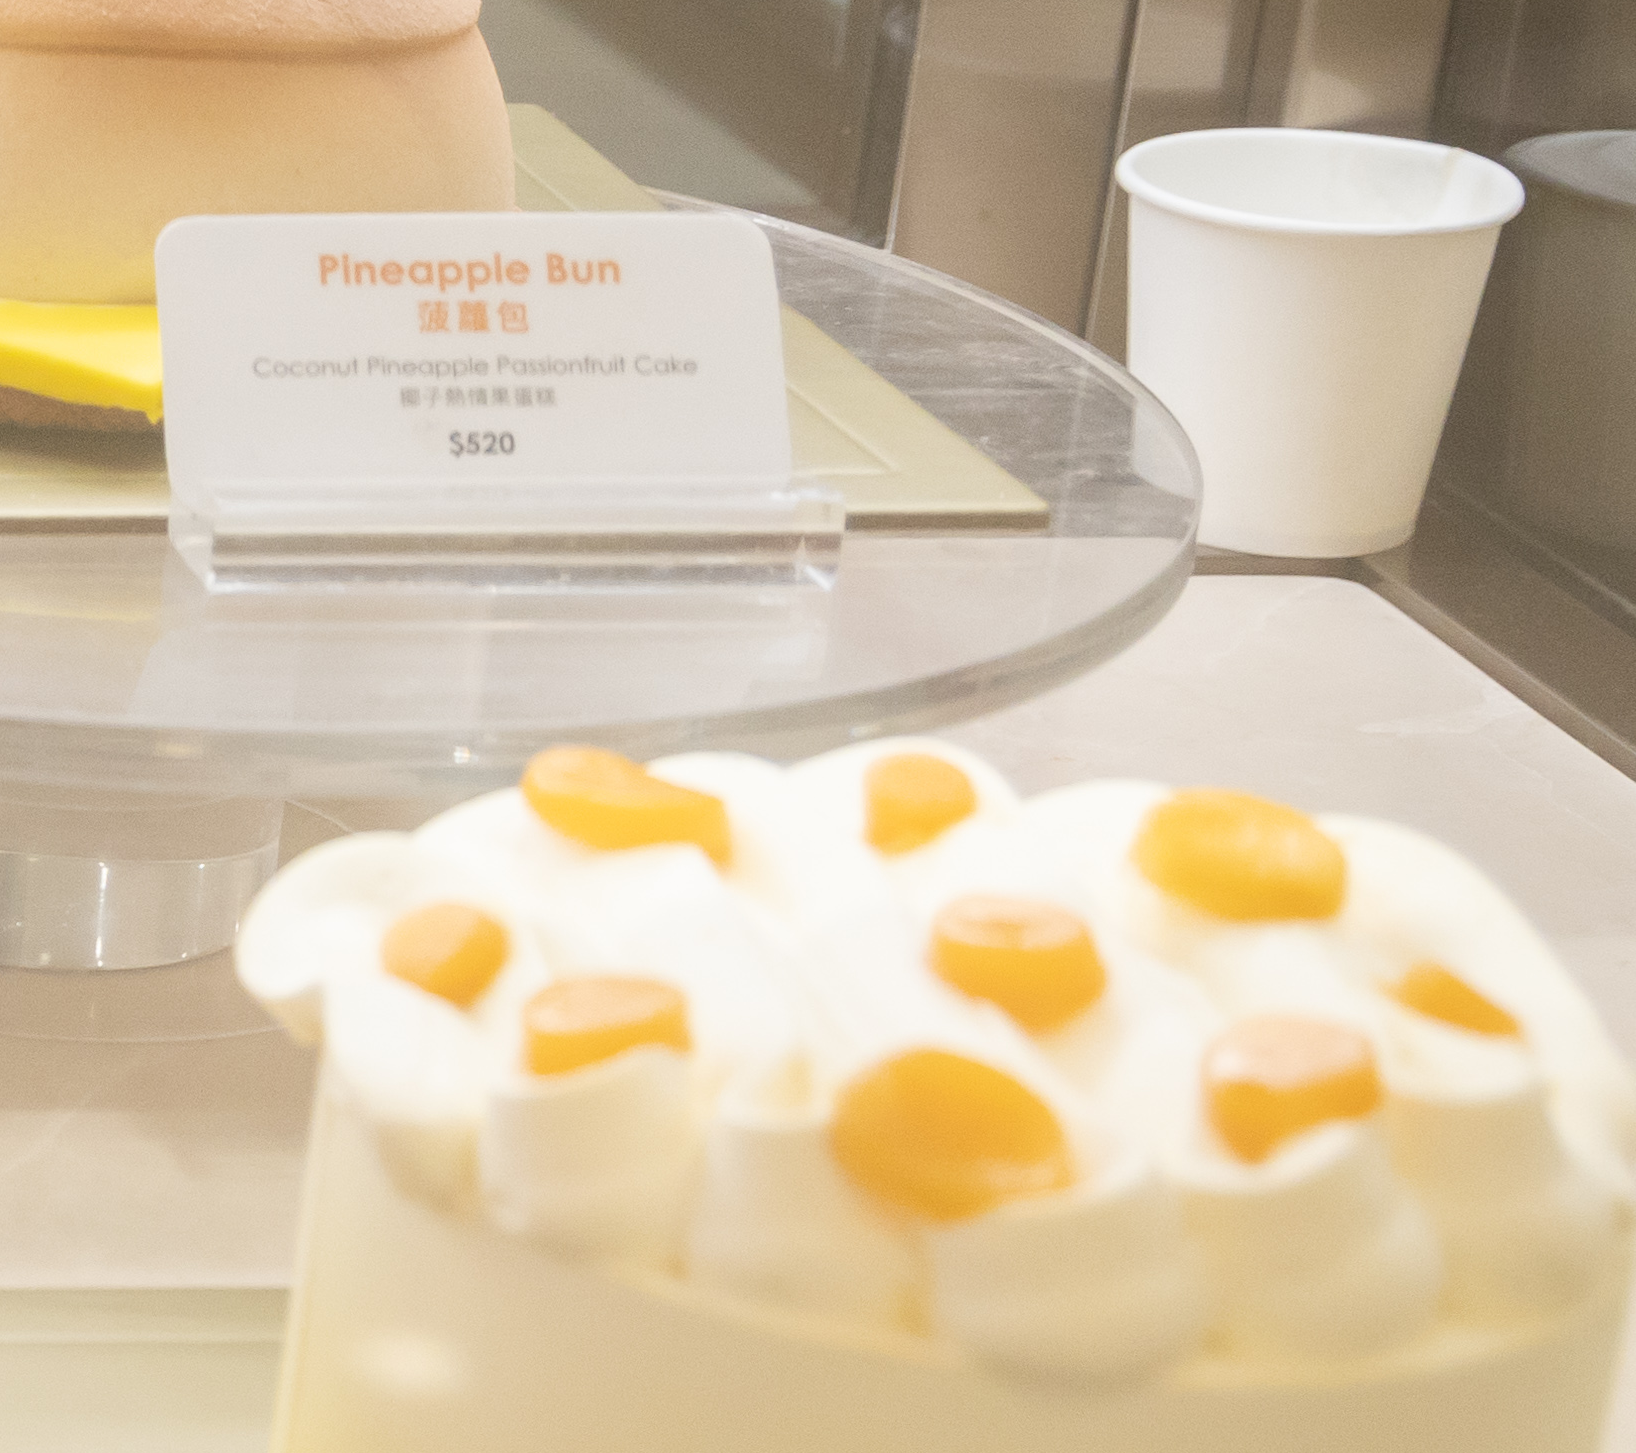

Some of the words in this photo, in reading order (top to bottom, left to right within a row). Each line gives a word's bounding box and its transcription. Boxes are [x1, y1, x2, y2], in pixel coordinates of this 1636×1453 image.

[317, 252, 532, 294] Pineapple
[545, 251, 623, 286] Bun
[418, 300, 529, 334] 菠蘿包
[251, 355, 361, 380] Coconut
[366, 354, 491, 382] Pineapple
[496, 353, 627, 378] Passionfruit
[633, 354, 700, 377] Cake
[448, 428, 517, 458] $520
